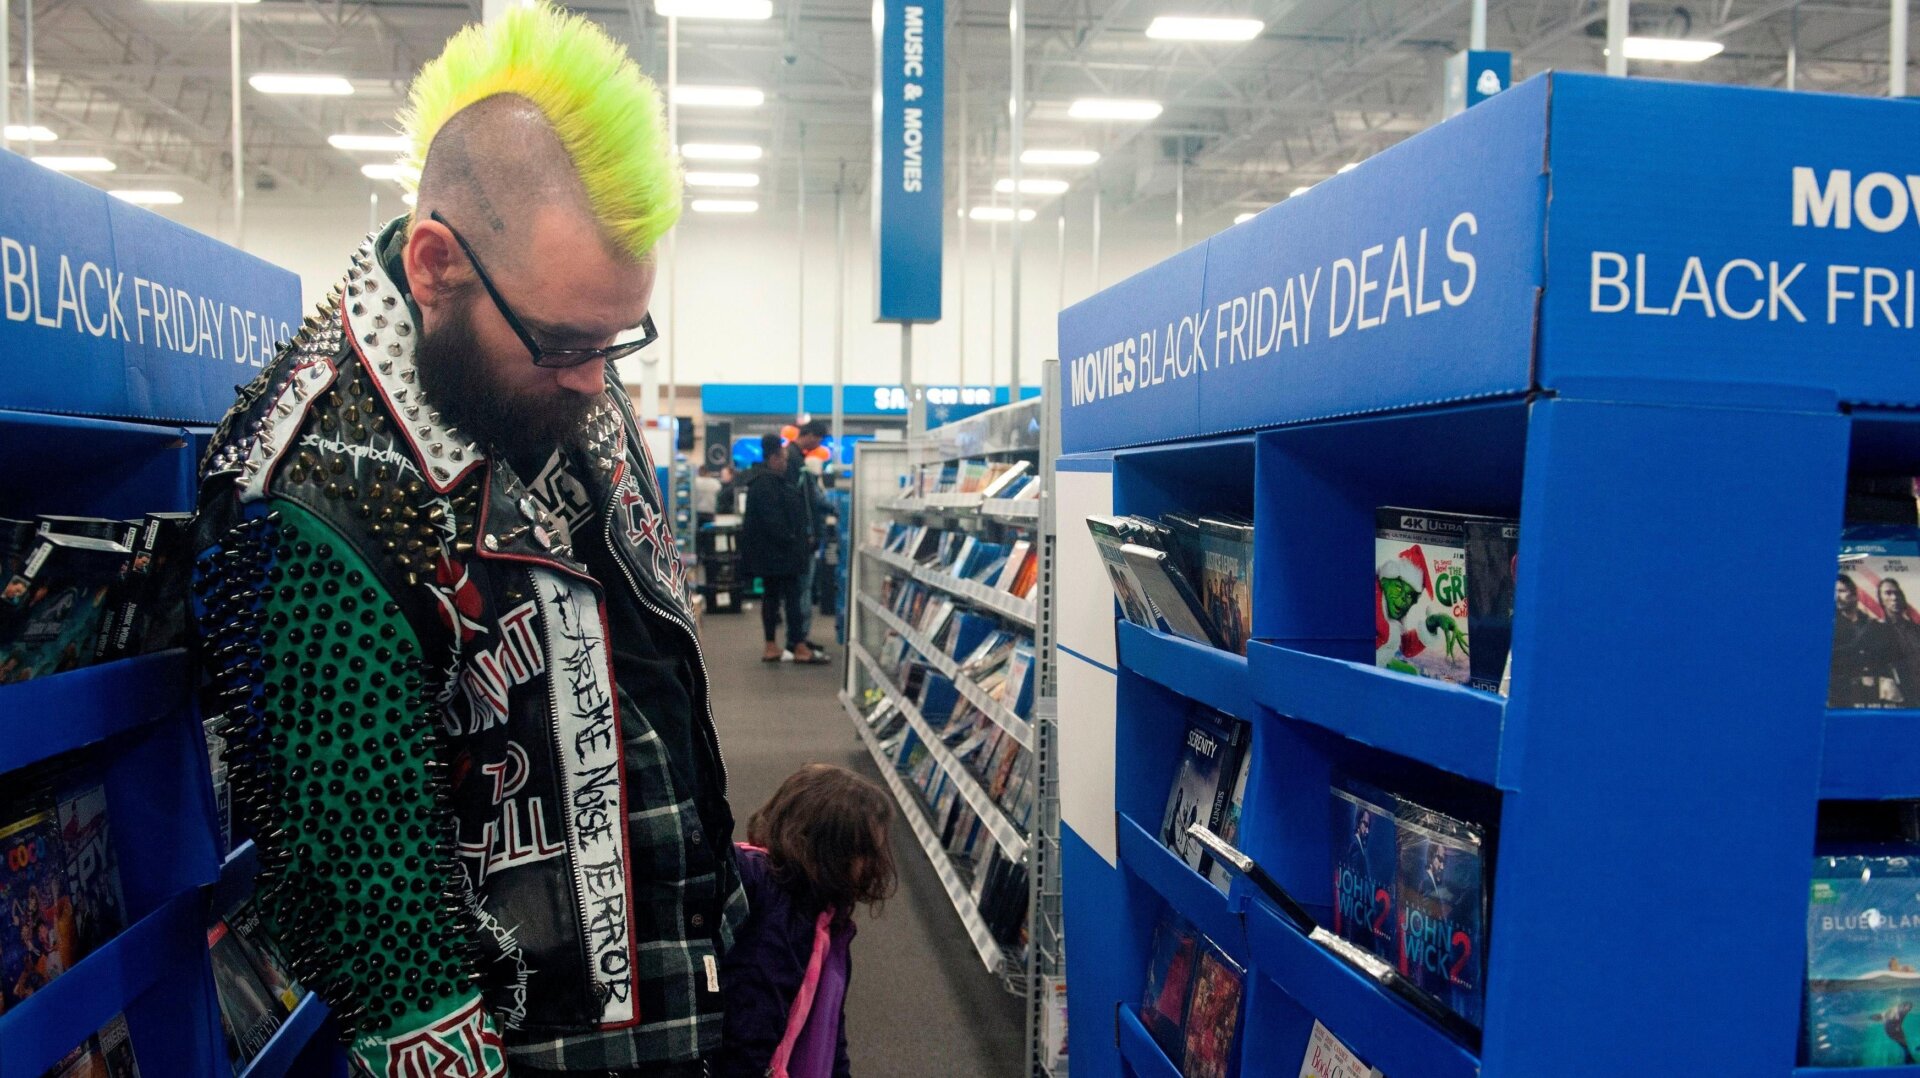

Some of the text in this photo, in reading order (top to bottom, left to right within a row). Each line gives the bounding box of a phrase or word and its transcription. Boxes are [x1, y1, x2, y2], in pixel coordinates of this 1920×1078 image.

[903, 6, 923, 192] MUSIC & MOVIES
[1791, 166, 1920, 233] MO
[1, 236, 131, 343] BLACK
[134, 276, 224, 361] FRIDAY
[1071, 212, 1478, 407] MOVIES BLACK FRIDAY DEALS
[1590, 251, 1916, 329] BLACK FRI
[1402, 517, 1463, 532] 4K ULTRA
[1187, 729, 1218, 759] SERENITY
[573, 763, 619, 853] NOISE
[1212, 791, 1225, 826] SERENITY
[1336, 867, 1376, 906] JOHN
[1337, 888, 1391, 933] WICK 2
[579, 850, 631, 1006] TERROR
[1402, 906, 1454, 948] JOHN
[1823, 915, 1872, 931] BLUE
[1403, 931, 1472, 984] WICK 2
